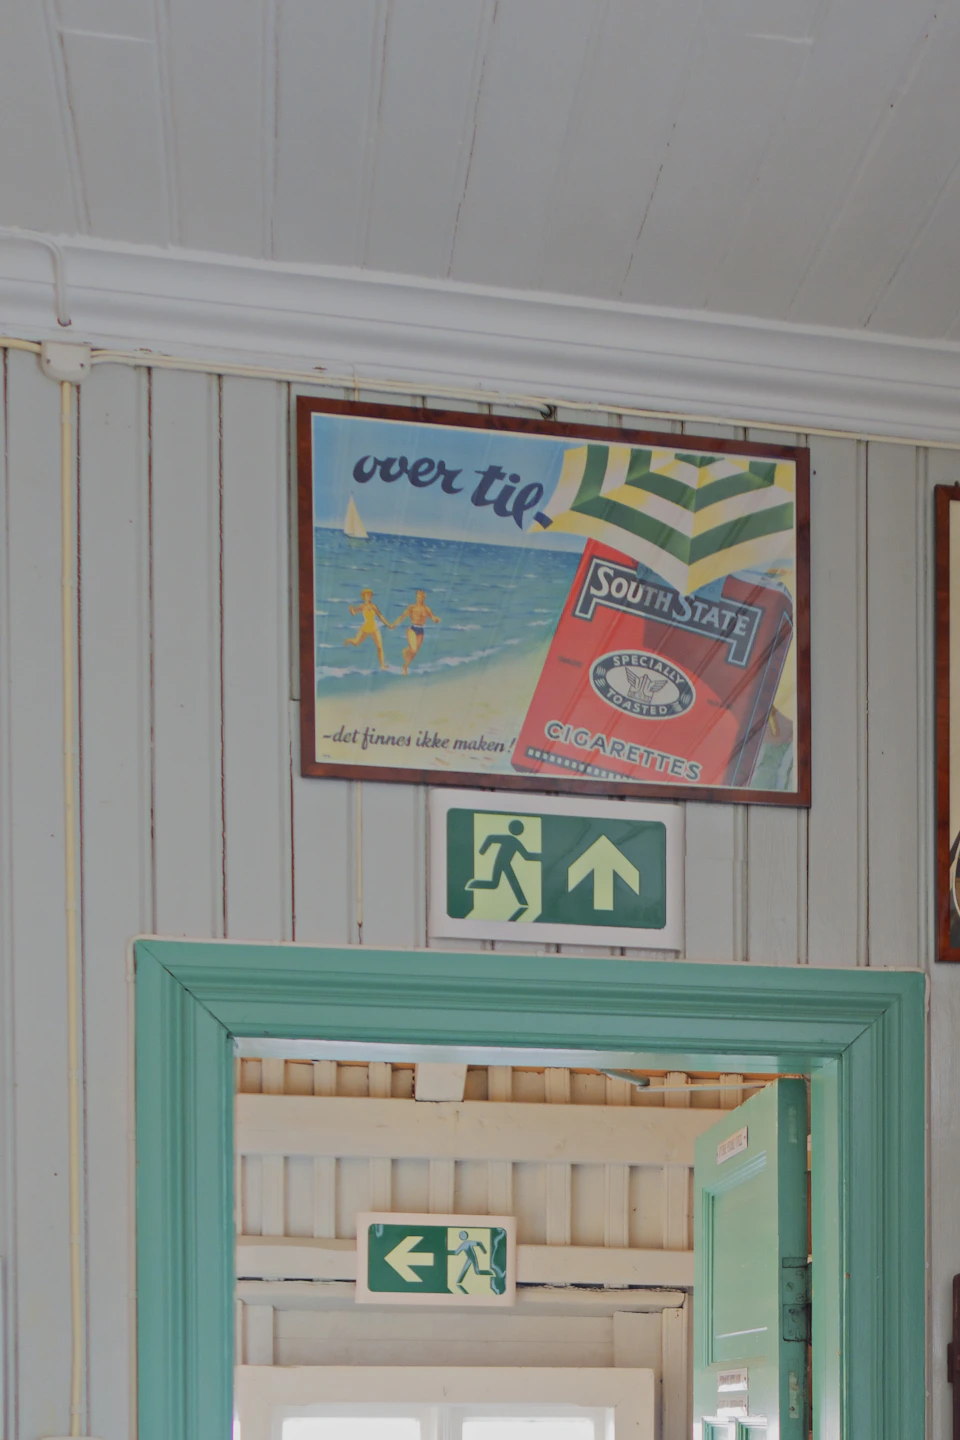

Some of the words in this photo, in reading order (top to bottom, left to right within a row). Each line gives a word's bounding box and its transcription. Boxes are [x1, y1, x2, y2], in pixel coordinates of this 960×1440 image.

[353, 455, 464, 495] over
[589, 566, 674, 614] SOUTH
[672, 594, 750, 637] STATE
[613, 655, 685, 684] SPECIALLY
[606, 688, 668, 715] TOASTED
[361, 727, 411, 750] finnes
[416, 731, 449, 749] ikke
[544, 720, 703, 782] CIGARETTES
